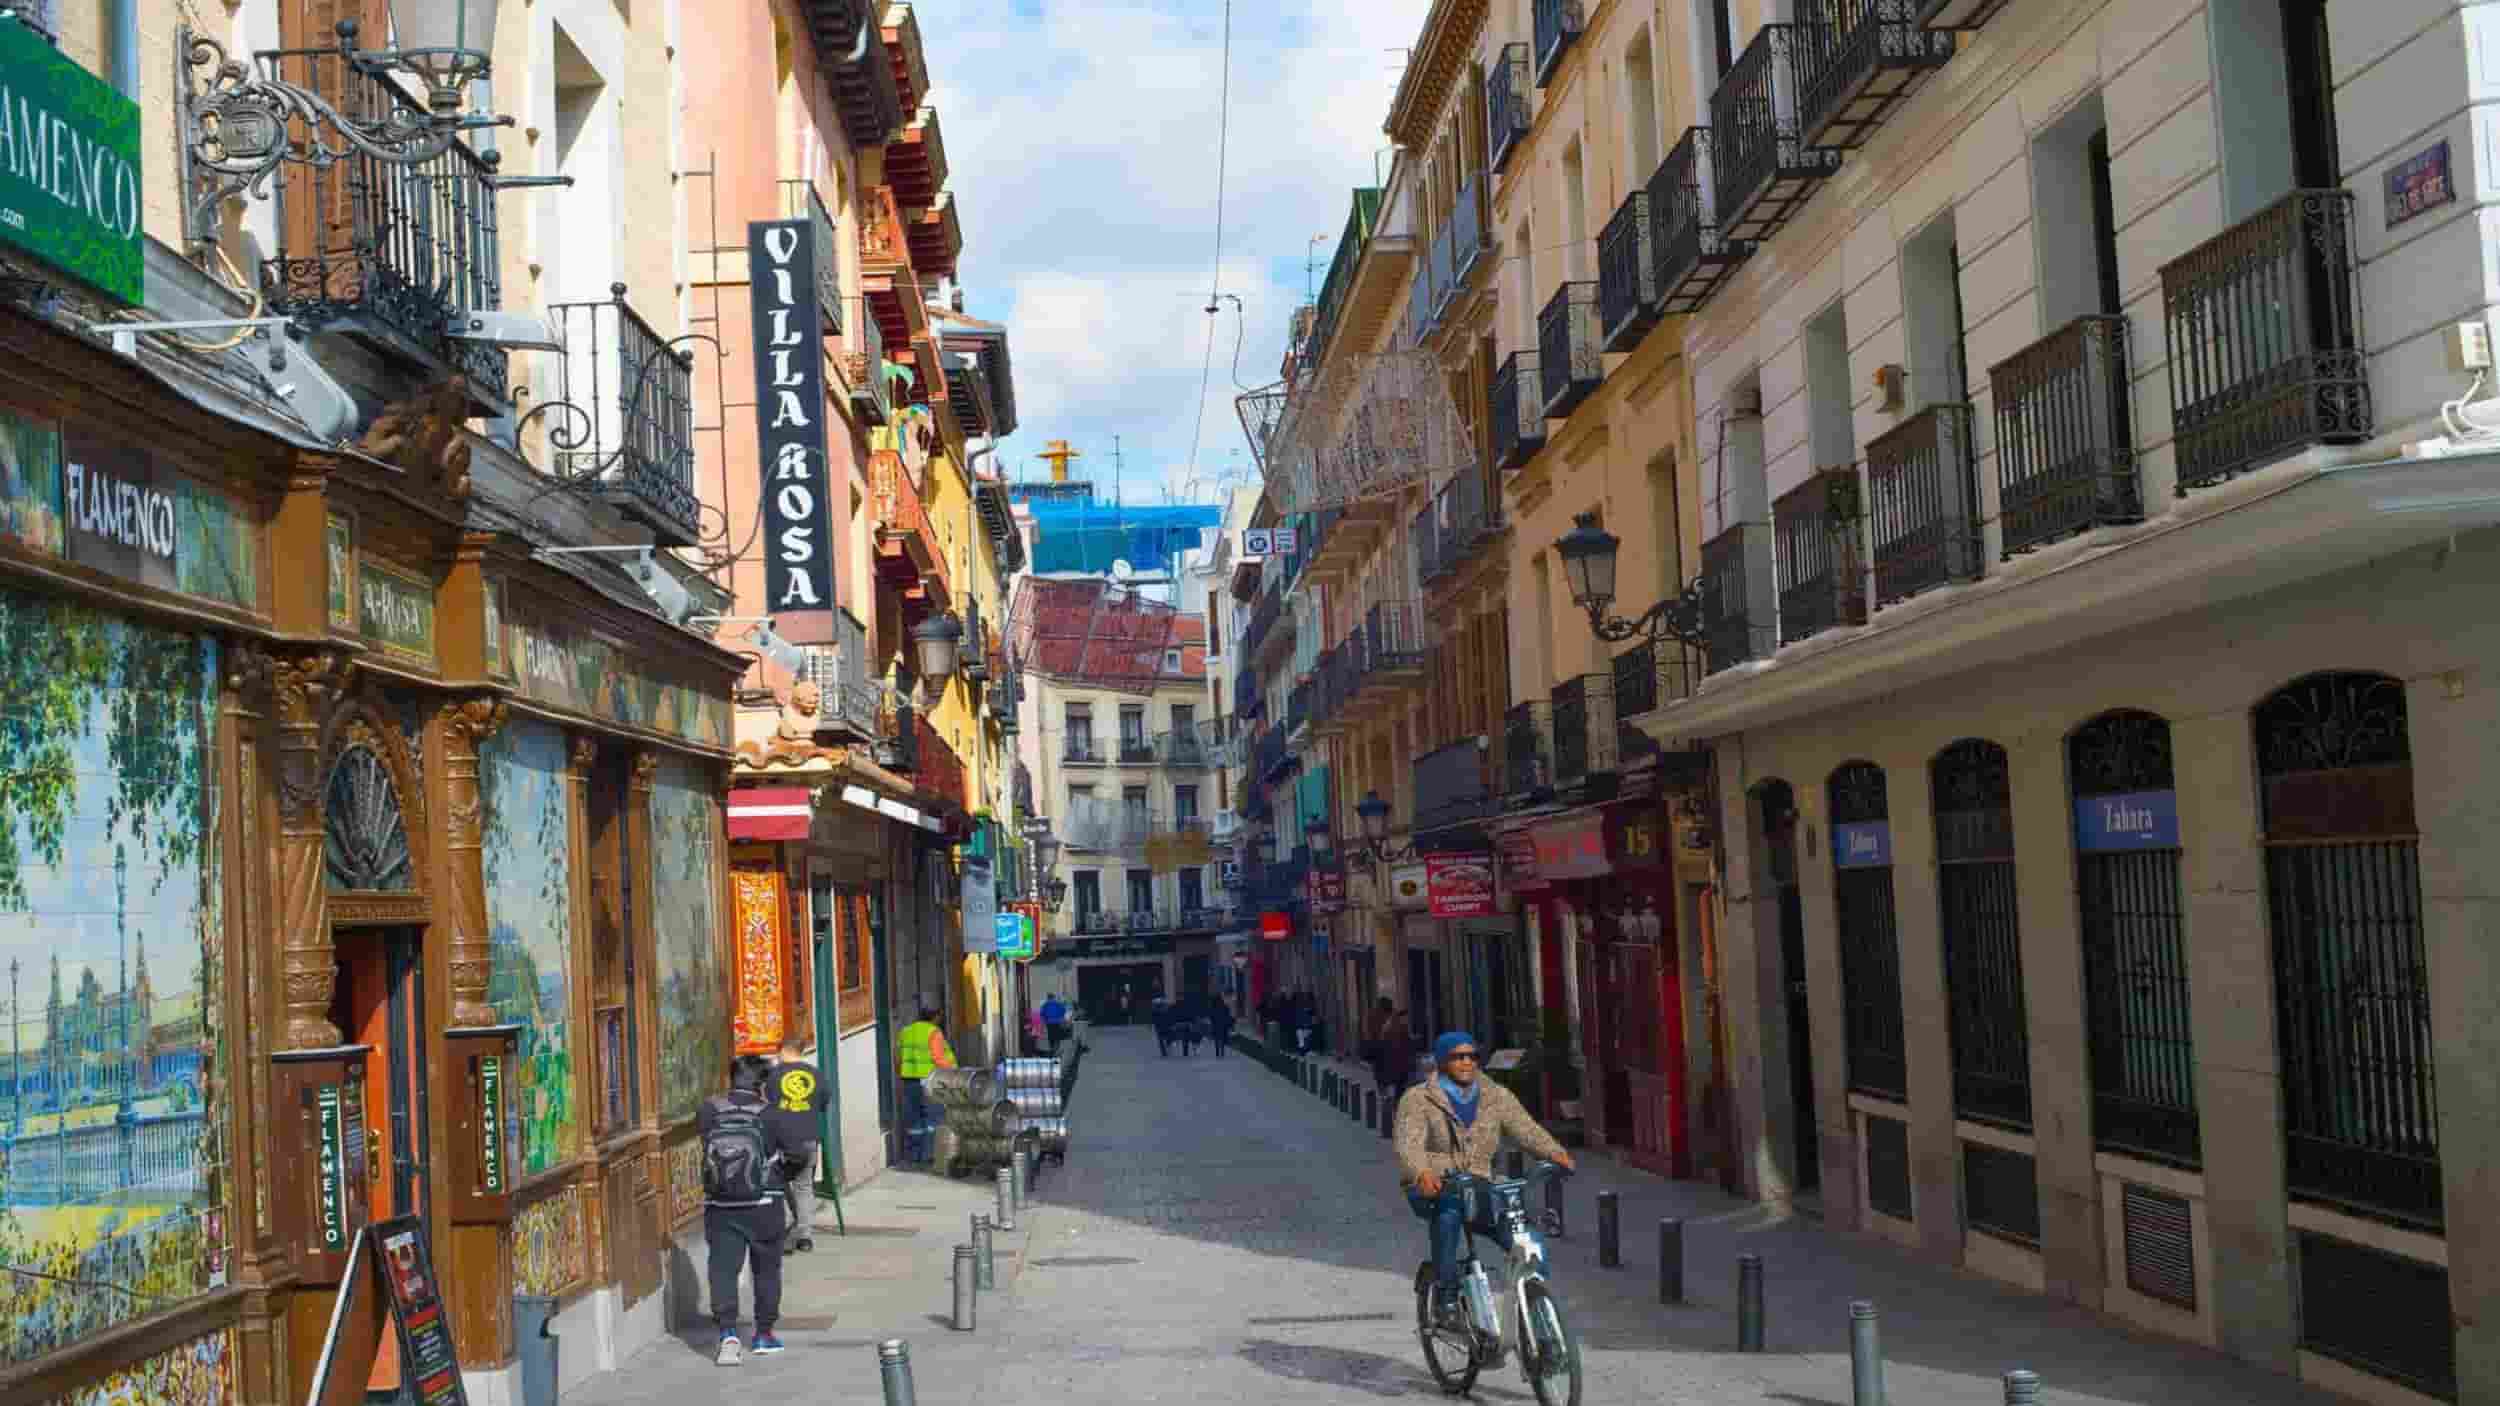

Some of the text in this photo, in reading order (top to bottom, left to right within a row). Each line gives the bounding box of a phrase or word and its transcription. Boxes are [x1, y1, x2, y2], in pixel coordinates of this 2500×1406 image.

[764, 227, 821, 605] VILLA ROSA
[66, 461, 174, 557] FLAMENCO
[319, 1110, 338, 1243] FLAMENCO
[484, 1079, 498, 1188] FLAMENCO
